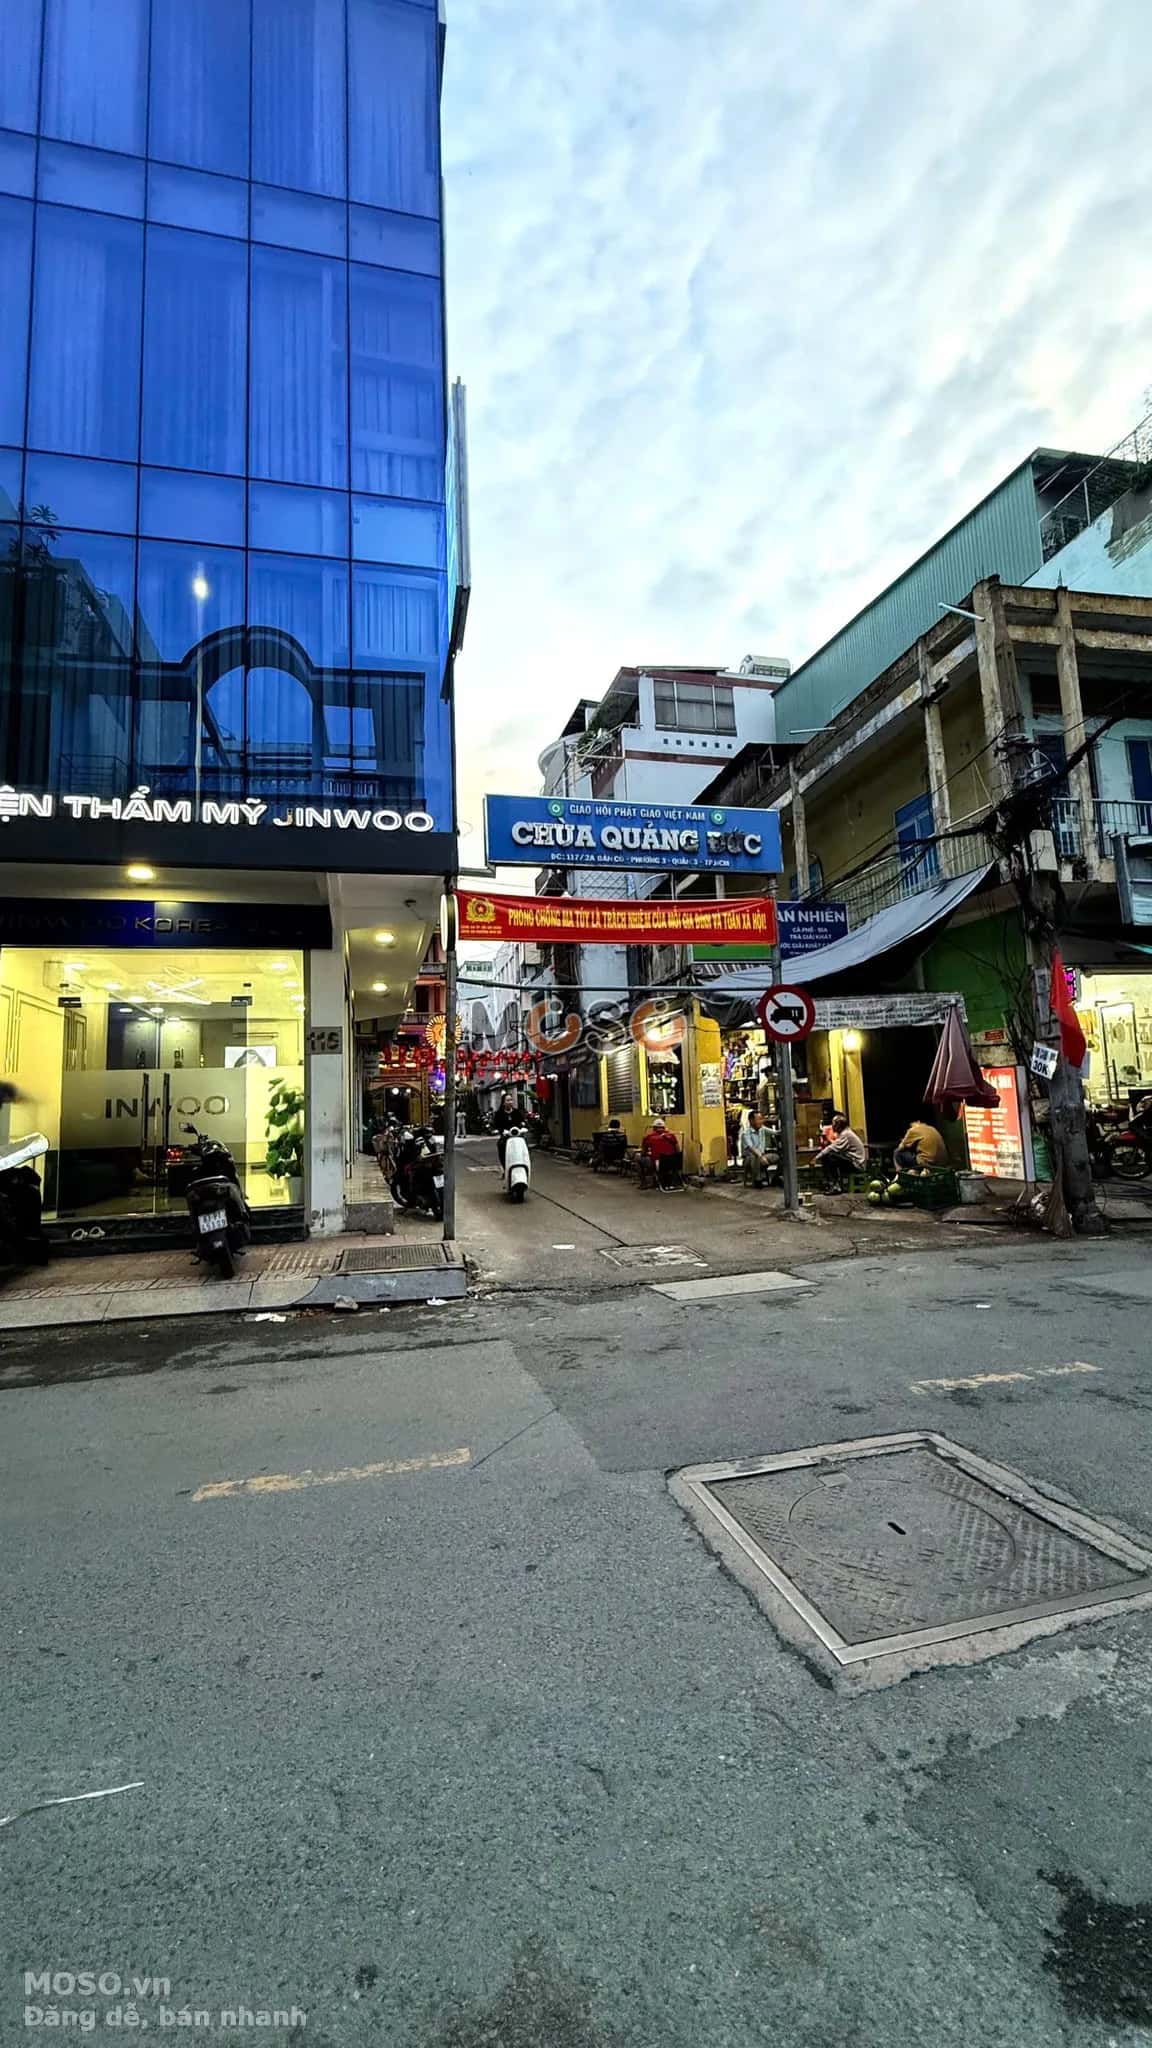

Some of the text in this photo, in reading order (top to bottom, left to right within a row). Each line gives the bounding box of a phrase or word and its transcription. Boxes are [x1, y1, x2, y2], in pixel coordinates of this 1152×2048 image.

[63, 785, 192, 823] THẨM
[202, 798, 268, 826] MỸ
[273, 807, 434, 833] JINWOO
[686, 810, 706, 821] NAM
[511, 817, 597, 848] CHÙA
[600, 821, 699, 853] QUẢNG
[508, 903, 534, 927] PHÒNG
[535, 903, 561, 928] CHỐNG
[602, 907, 627, 929] TRÁCH
[1033, 1060, 1049, 1075] 30K
